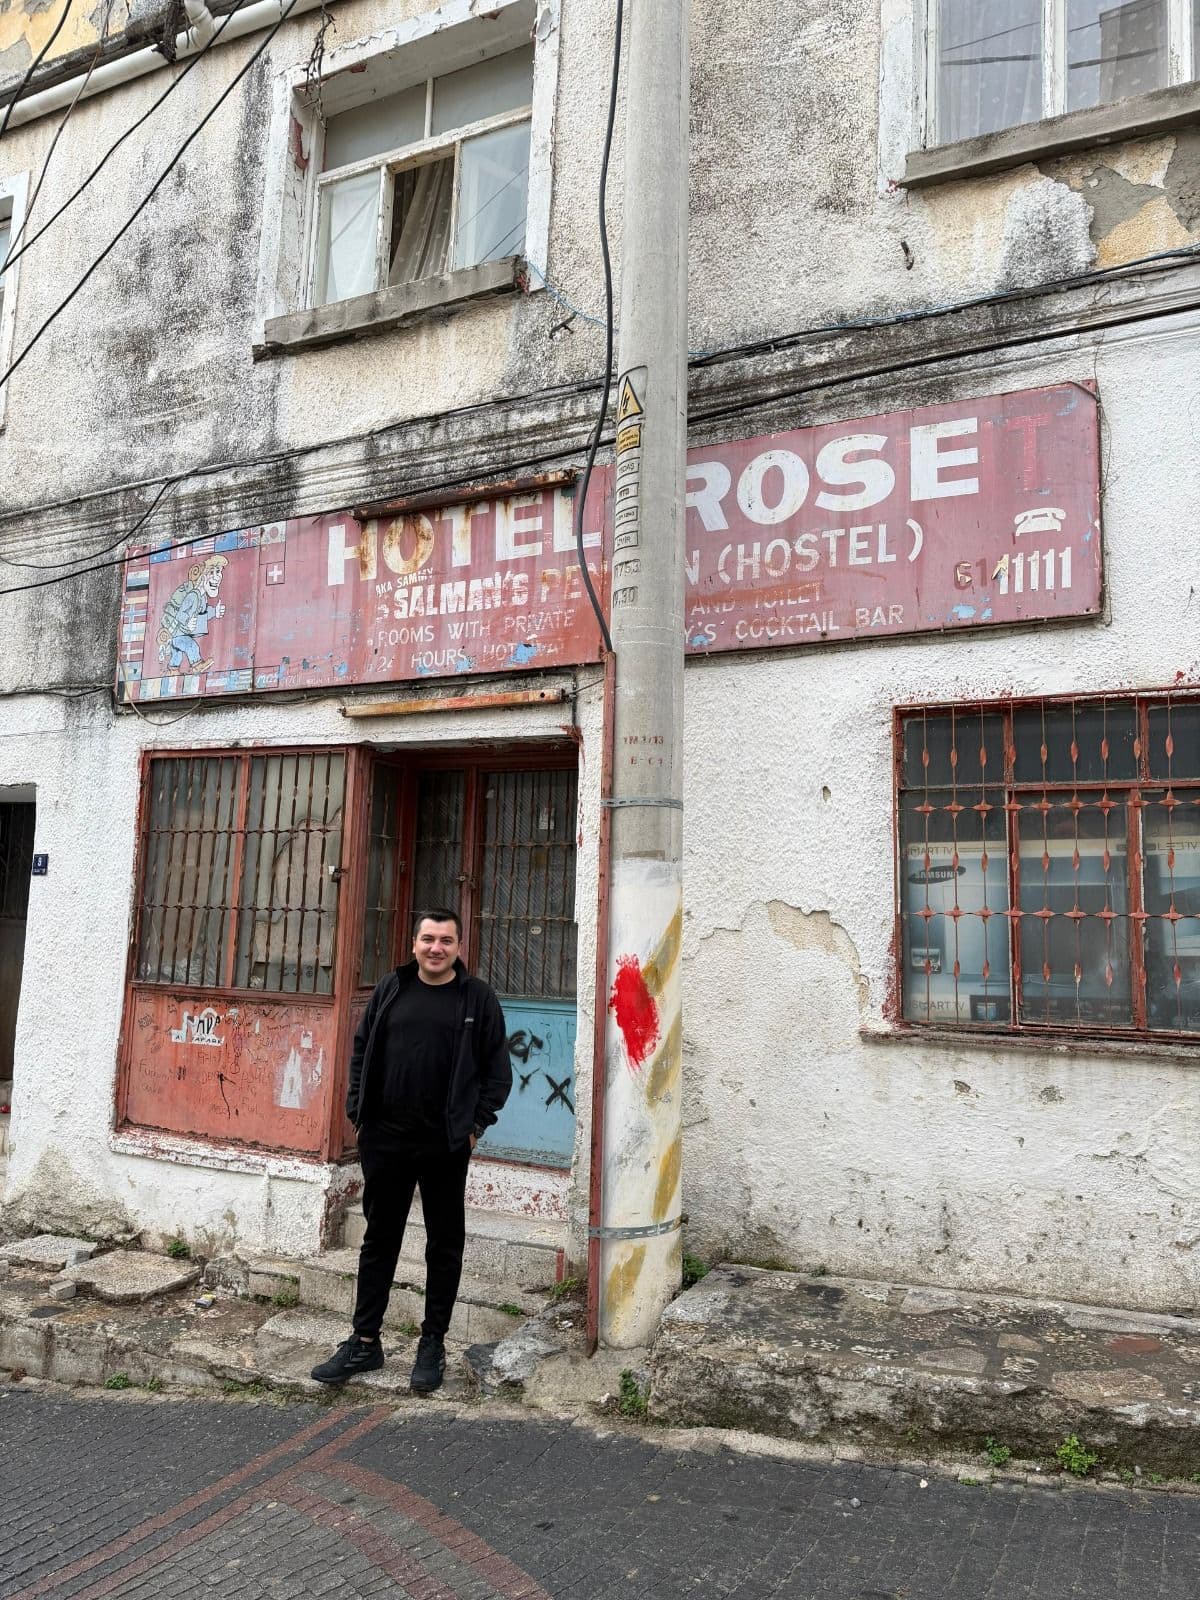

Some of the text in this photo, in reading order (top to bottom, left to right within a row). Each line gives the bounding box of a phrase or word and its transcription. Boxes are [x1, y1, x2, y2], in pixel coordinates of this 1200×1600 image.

[328, 417, 979, 586] HOTEL ROSE
[448, 620, 491, 641] WITH
[735, 610, 841, 640] COCKTAIL
[855, 603, 904, 628] BAR
